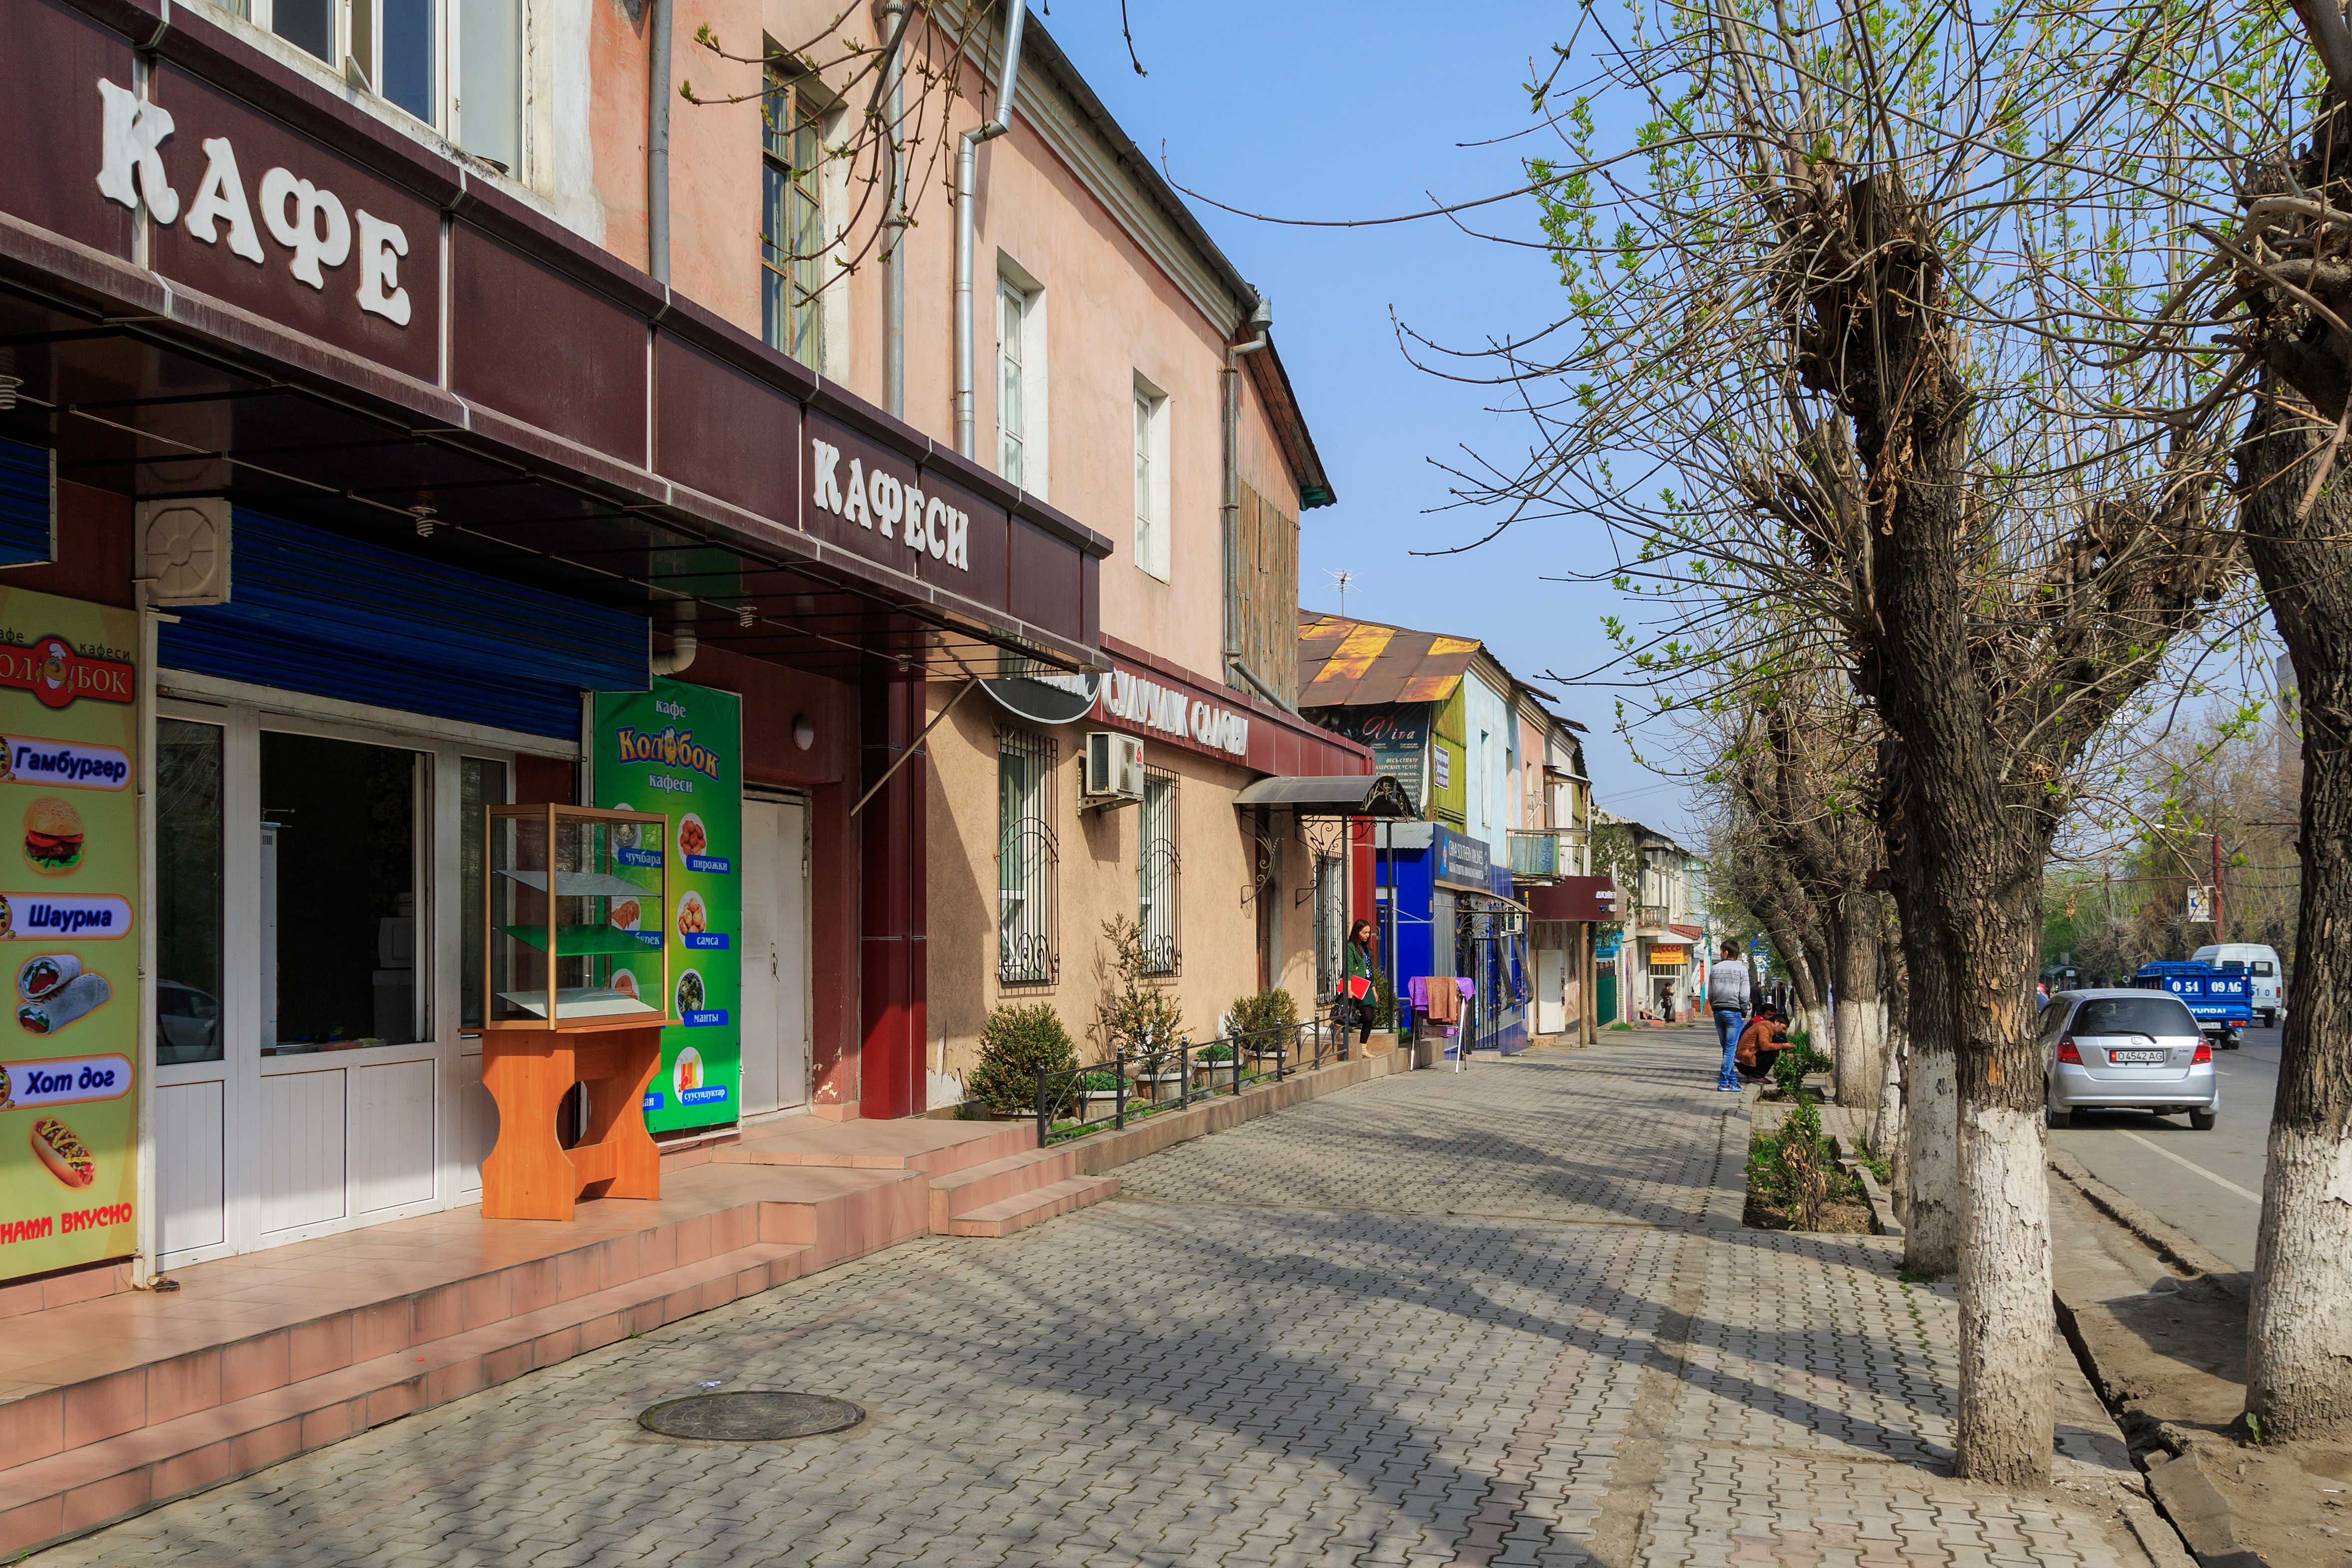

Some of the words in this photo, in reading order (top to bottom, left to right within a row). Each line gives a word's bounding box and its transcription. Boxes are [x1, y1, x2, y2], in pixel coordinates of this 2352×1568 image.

[96, 77, 411, 327] КАФЕ
[812, 438, 969, 572] КАФЕСИ
[0, 627, 24, 644] афе
[80, 643, 130, 660] кафеси
[655, 700, 686, 720] кафе
[1101, 666, 1189, 738] СУЛУУЛУК
[1190, 701, 1248, 756] САЛОНУ
[15, 747, 126, 783] Гамбургер
[649, 774, 693, 793] кафеси
[625, 851, 661, 867] чучбара
[693, 859, 728, 871] пирожки
[28, 905, 112, 932] Шаурма
[697, 935, 719, 946] самса
[2185, 981, 2199, 992] 54
[2211, 981, 2225, 992] 09
[2227, 981, 2242, 992] AG
[693, 1013, 719, 1023] манты
[25, 1071, 72, 1095] Хот
[78, 1067, 115, 1090] дог
[0, 1216, 52, 1244] НАМИ
[61, 1202, 132, 1234] ВКУСНО
